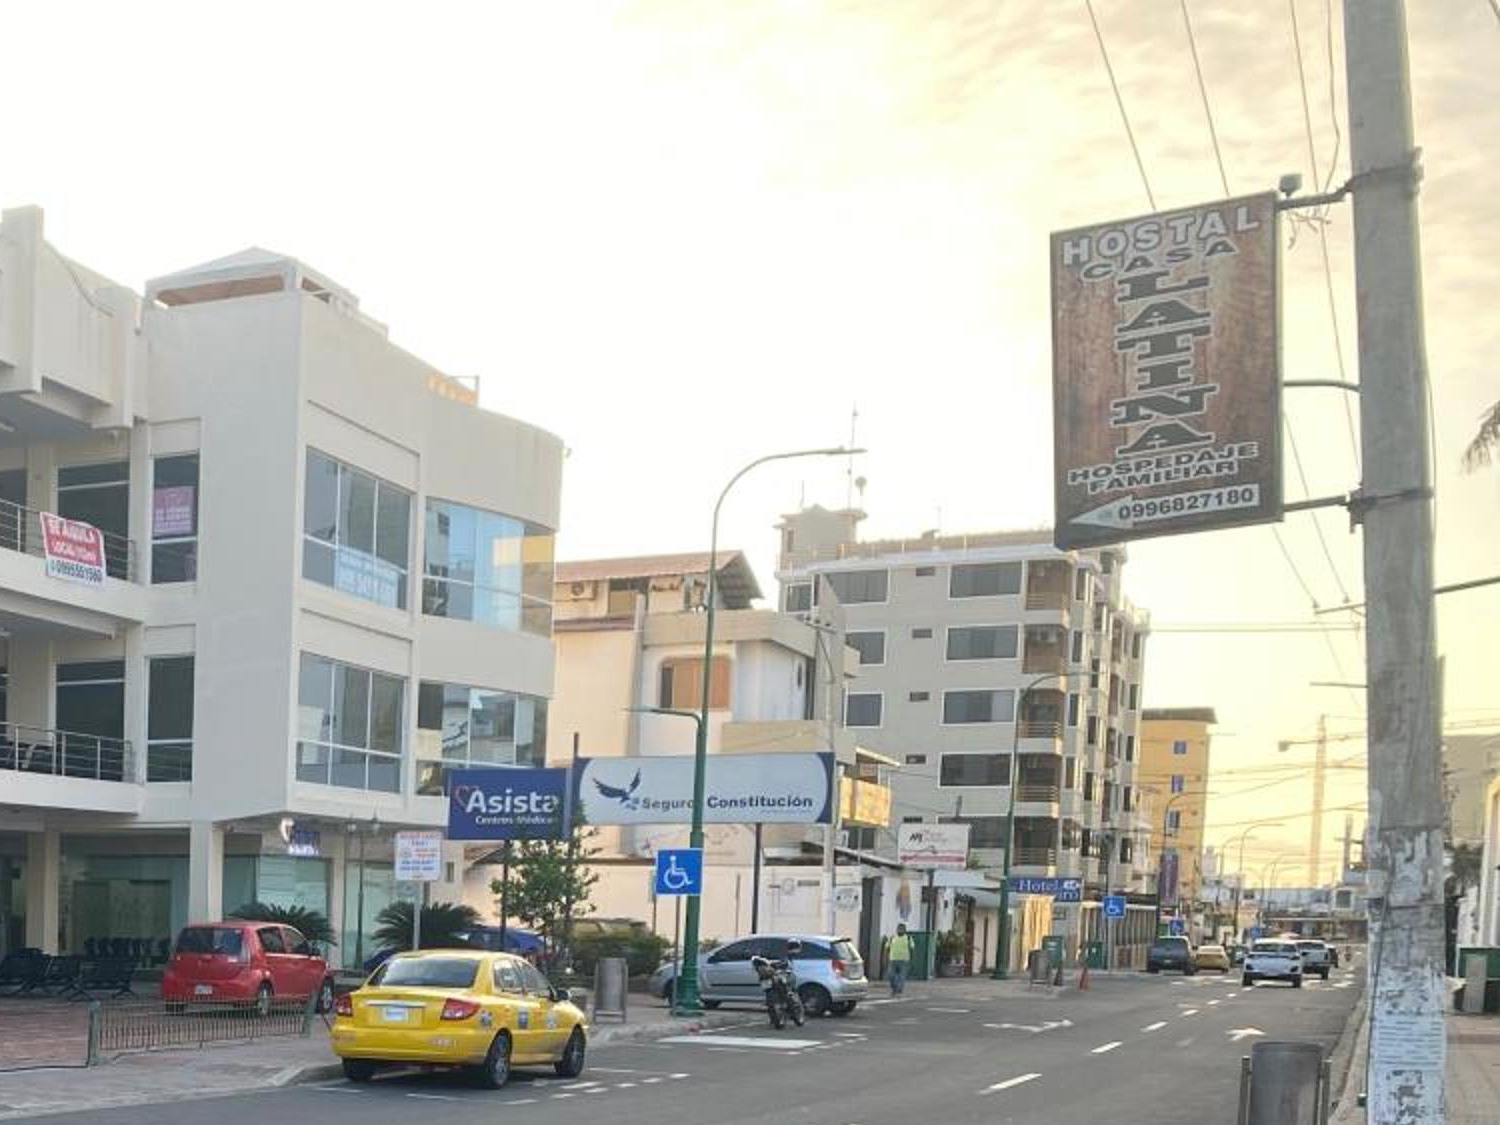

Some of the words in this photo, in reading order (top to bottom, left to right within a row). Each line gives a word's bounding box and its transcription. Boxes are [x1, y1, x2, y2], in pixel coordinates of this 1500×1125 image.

[1062, 207, 1260, 265] HOSTAL
[1083, 237, 1237, 281] CASA
[1068, 443, 1258, 484] HOSPEDAJE
[1088, 460, 1238, 493] FAMILIAR
[1119, 487, 1254, 520] 0996827180
[466, 788, 559, 813] Asista
[642, 799, 694, 811] Seguro
[707, 794, 813, 808] Constitución
